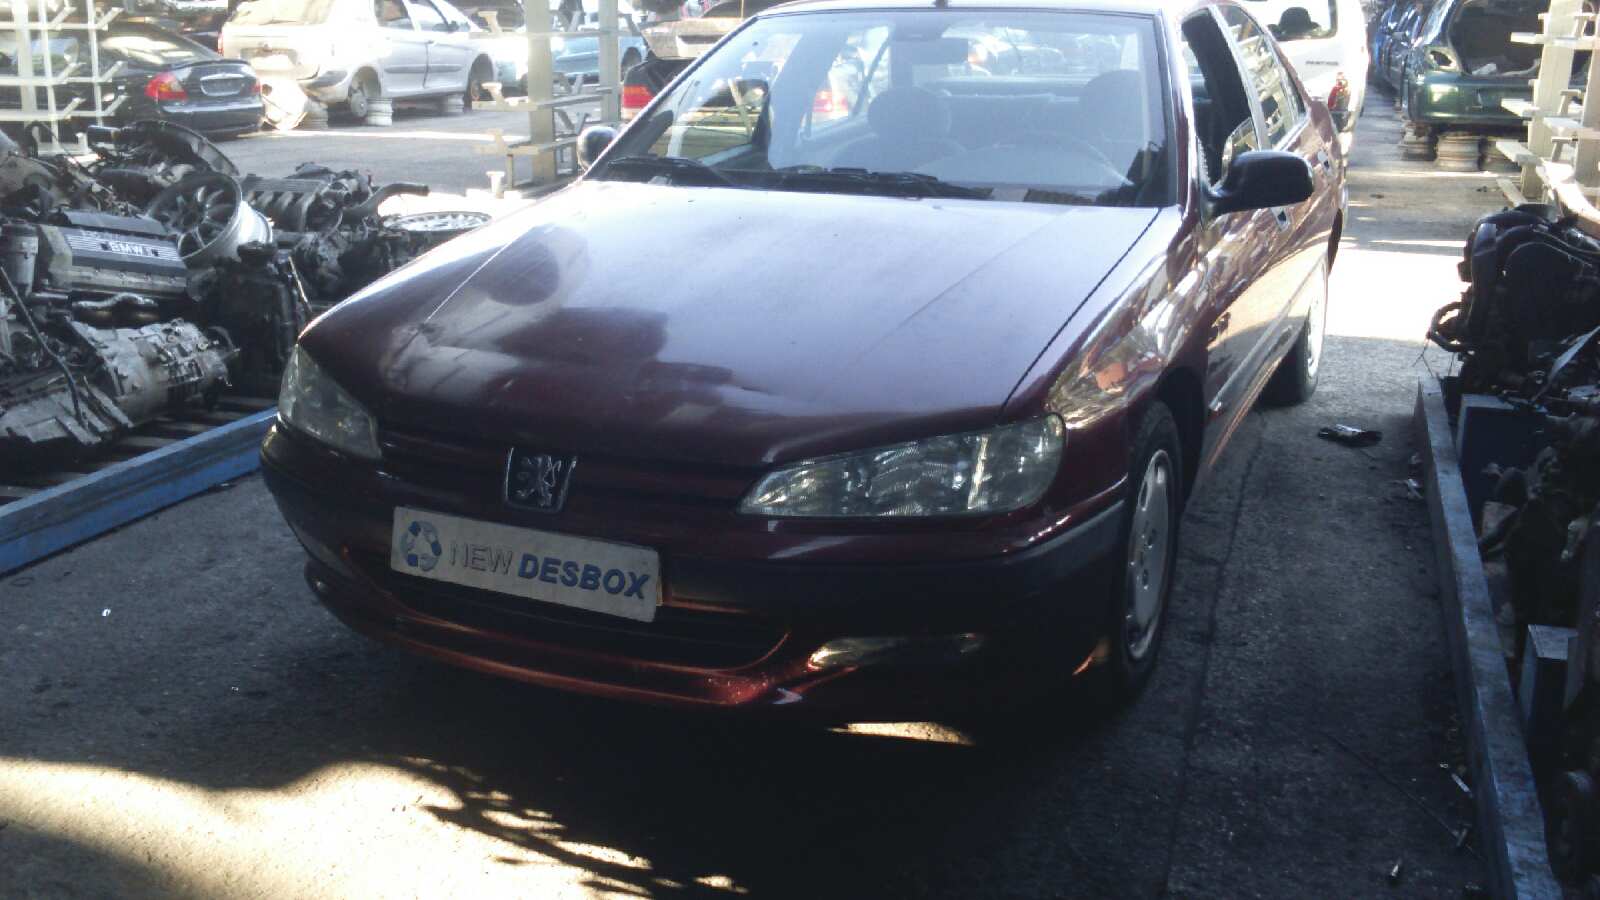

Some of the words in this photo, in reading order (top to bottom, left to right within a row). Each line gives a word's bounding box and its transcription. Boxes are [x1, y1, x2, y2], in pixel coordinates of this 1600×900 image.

[111, 241, 143, 256] BMW
[449, 542, 513, 575] NEW
[518, 553, 650, 599] DESBOX
